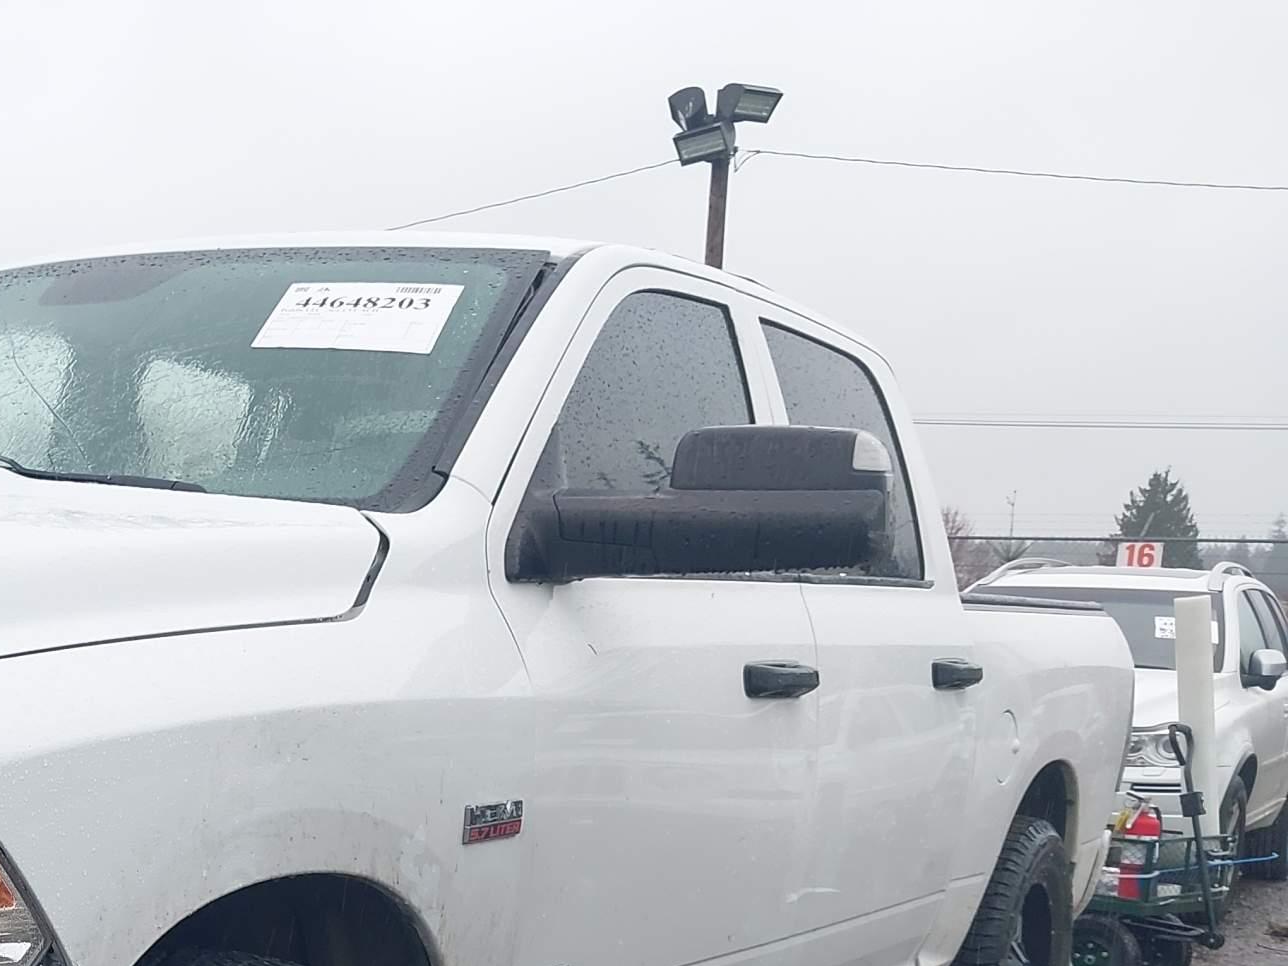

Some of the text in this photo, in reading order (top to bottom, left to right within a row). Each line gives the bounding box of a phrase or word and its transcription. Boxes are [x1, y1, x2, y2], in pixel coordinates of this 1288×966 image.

[296, 296, 431, 310] 44648203
[1125, 543, 1156, 568] 16
[490, 819, 522, 838] LITER
